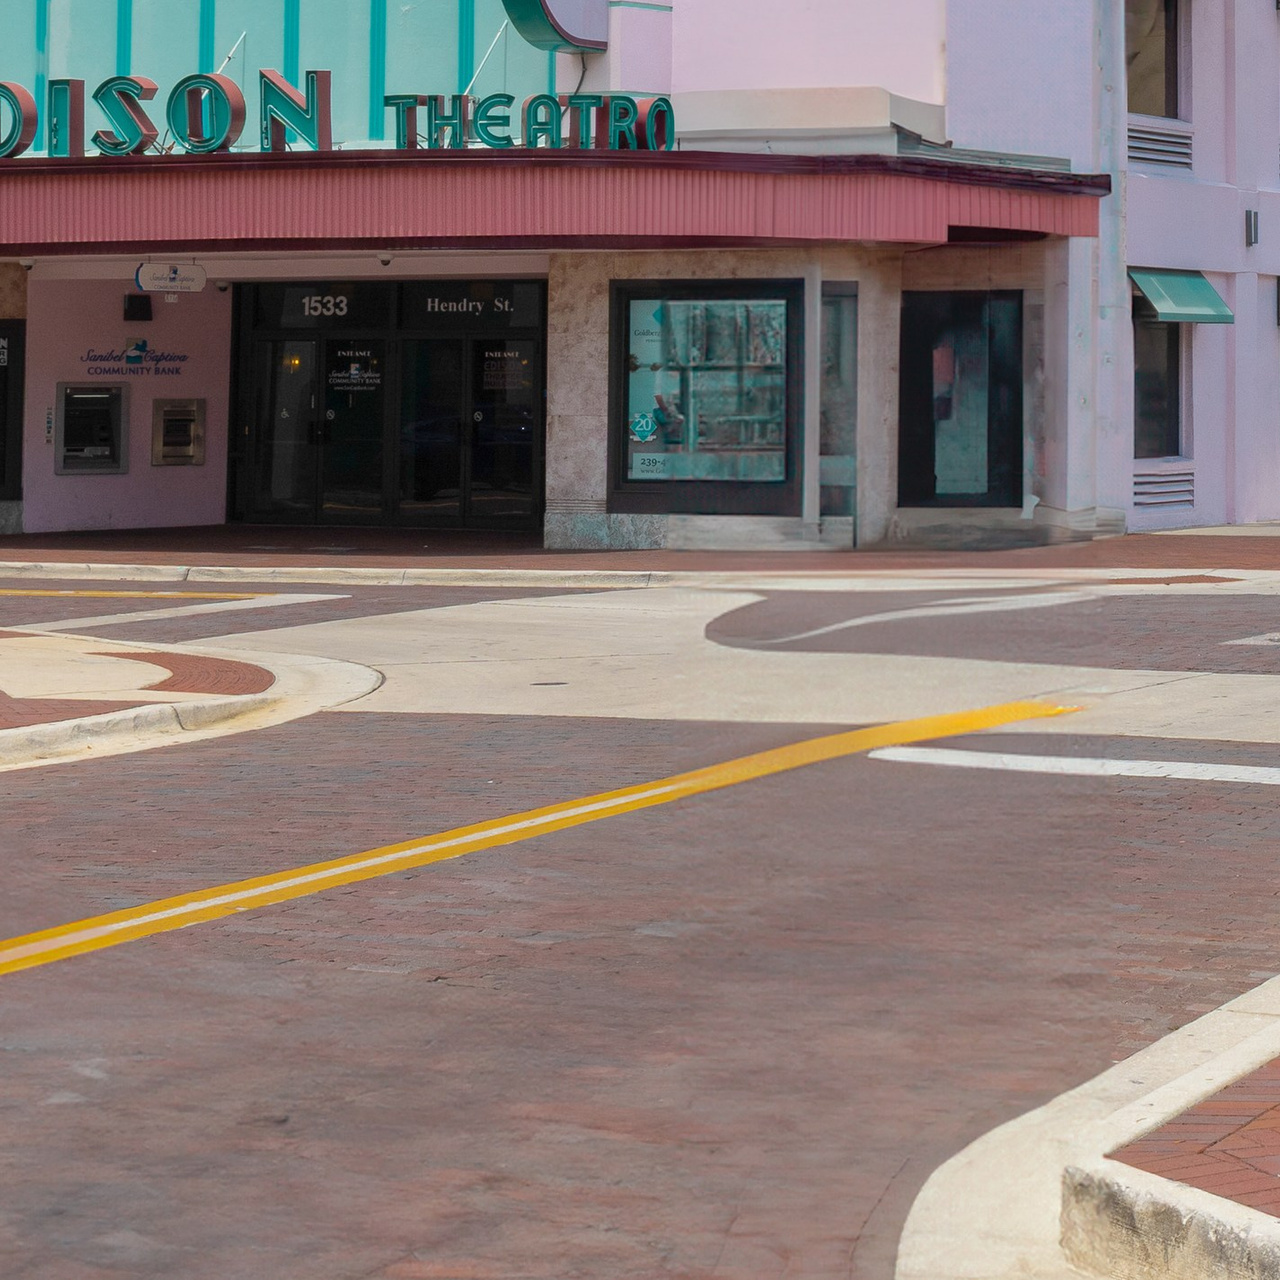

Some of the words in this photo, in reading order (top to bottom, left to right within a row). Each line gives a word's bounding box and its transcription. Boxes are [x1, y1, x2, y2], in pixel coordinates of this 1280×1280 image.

[302, 295, 348, 316] 1533
[427, 298, 485, 316] Hendry
[494, 297, 514, 312] St.
[80, 349, 126, 362] Sanibel
[144, 349, 188, 366] Captiva
[87, 366, 152, 376] COMMUNITY
[154, 366, 182, 376] BANK
[635, 418, 652, 431] 20
